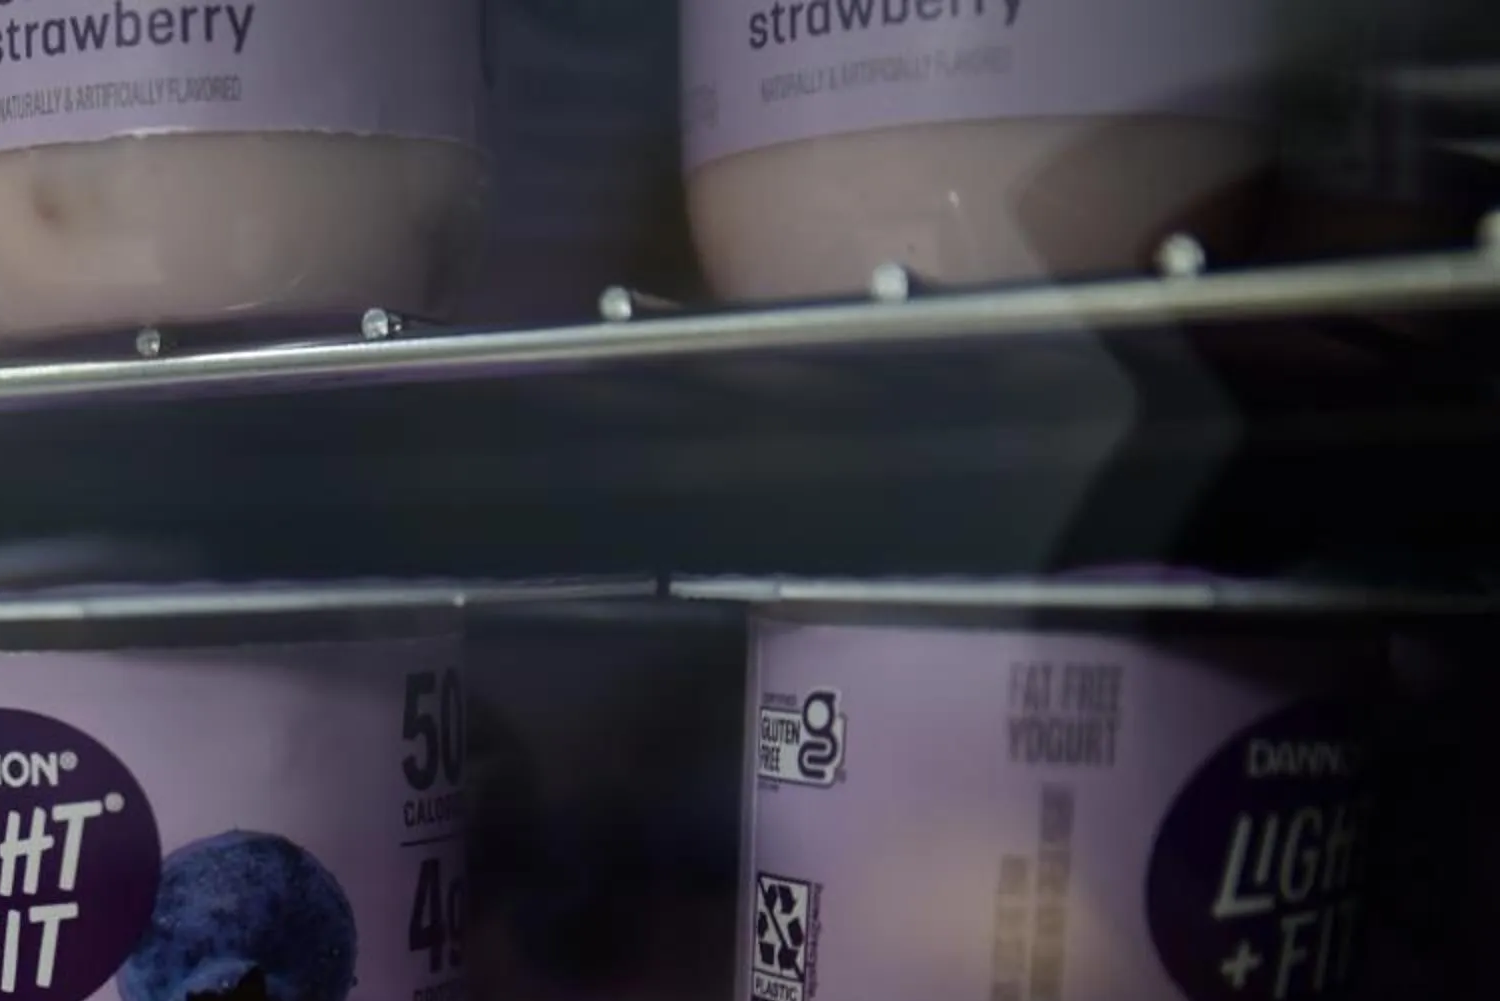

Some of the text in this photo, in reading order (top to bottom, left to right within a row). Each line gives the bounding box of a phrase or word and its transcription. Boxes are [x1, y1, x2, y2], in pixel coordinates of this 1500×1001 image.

[402, 667, 464, 791] 50
[761, 715, 800, 744] GLUTEN
[1007, 716, 1117, 767] YOGURT
[1248, 738, 1364, 779] DANN
[1210, 804, 1358, 919] LIGH
